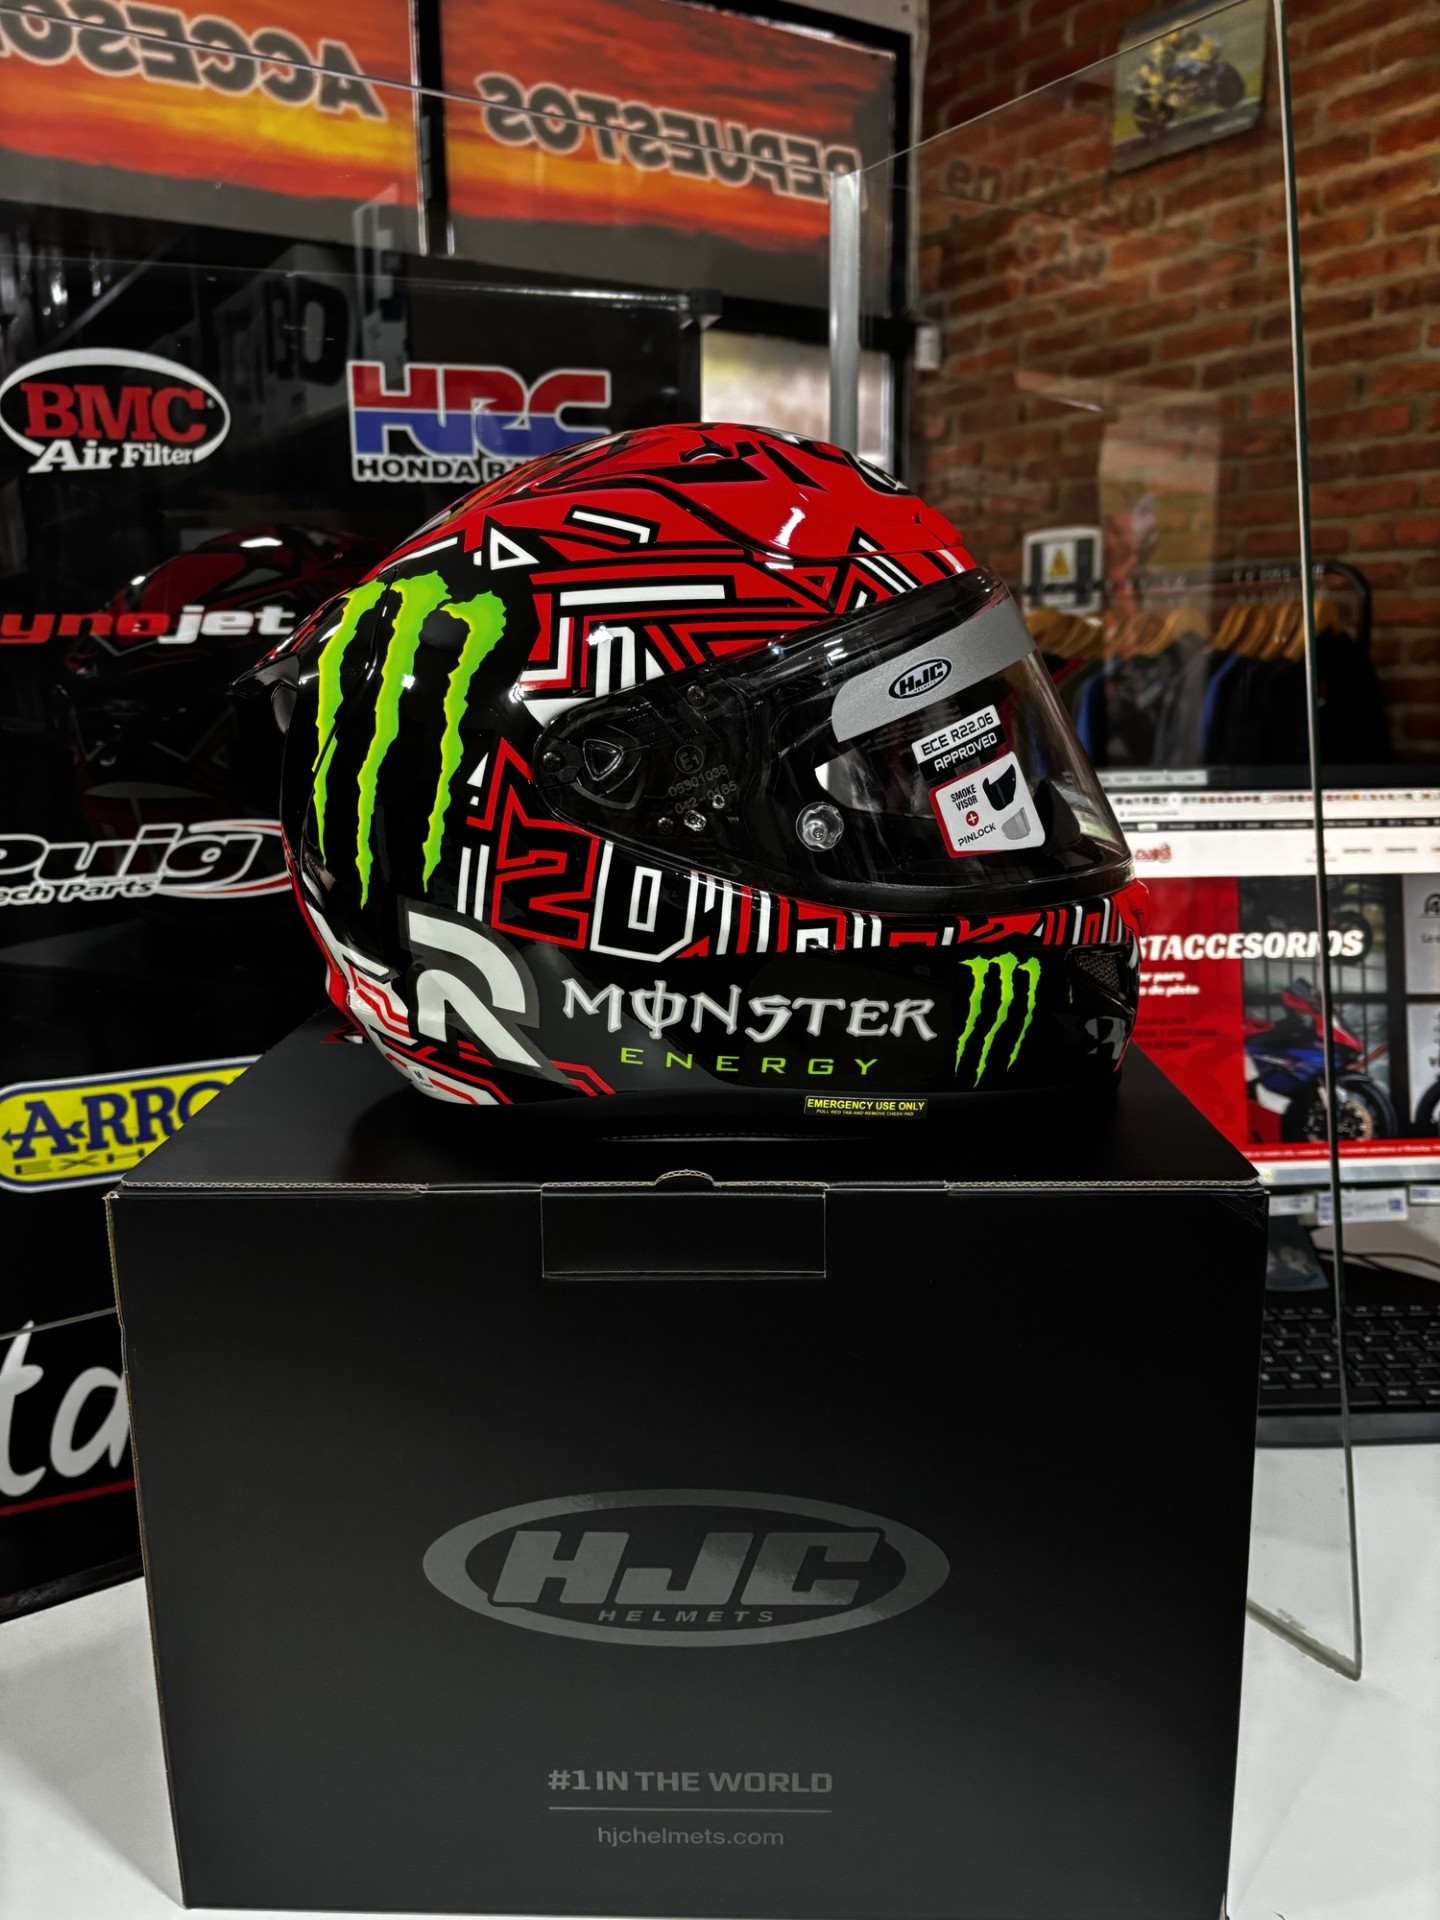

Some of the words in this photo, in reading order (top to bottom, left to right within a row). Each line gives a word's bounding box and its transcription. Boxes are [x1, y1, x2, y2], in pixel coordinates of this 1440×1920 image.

[20, 382, 207, 443] BMC
[347, 361, 611, 460] HRC
[27, 439, 118, 474] Air
[353, 457, 481, 482] HONDA
[899, 661, 944, 696] HJC
[921, 733, 950, 756] ECE
[950, 712, 994, 742] R22.06
[934, 731, 998, 772] APPROVED
[950, 784, 977, 803] SMOKE
[955, 795, 979, 812] VISOR
[957, 823, 996, 847] PINLOCK
[57, 878, 159, 903] Parts
[562, 978, 937, 1043] MONSTER
[620, 1046, 879, 1076] ENERGY
[807, 1098, 874, 1110] EMERGENCY
[875, 1101, 896, 1111] USE
[898, 1101, 925, 1111] ONLY
[493, 1531, 881, 1605] HJC
[598, 1610, 774, 1623] HELMETS
[548, 1769, 591, 1791] #1
[597, 1770, 629, 1792] IN
[634, 1771, 700, 1792] THE
[708, 1772, 833, 1793] WORLD
[598, 1826, 784, 1847] hjchelmets.com
